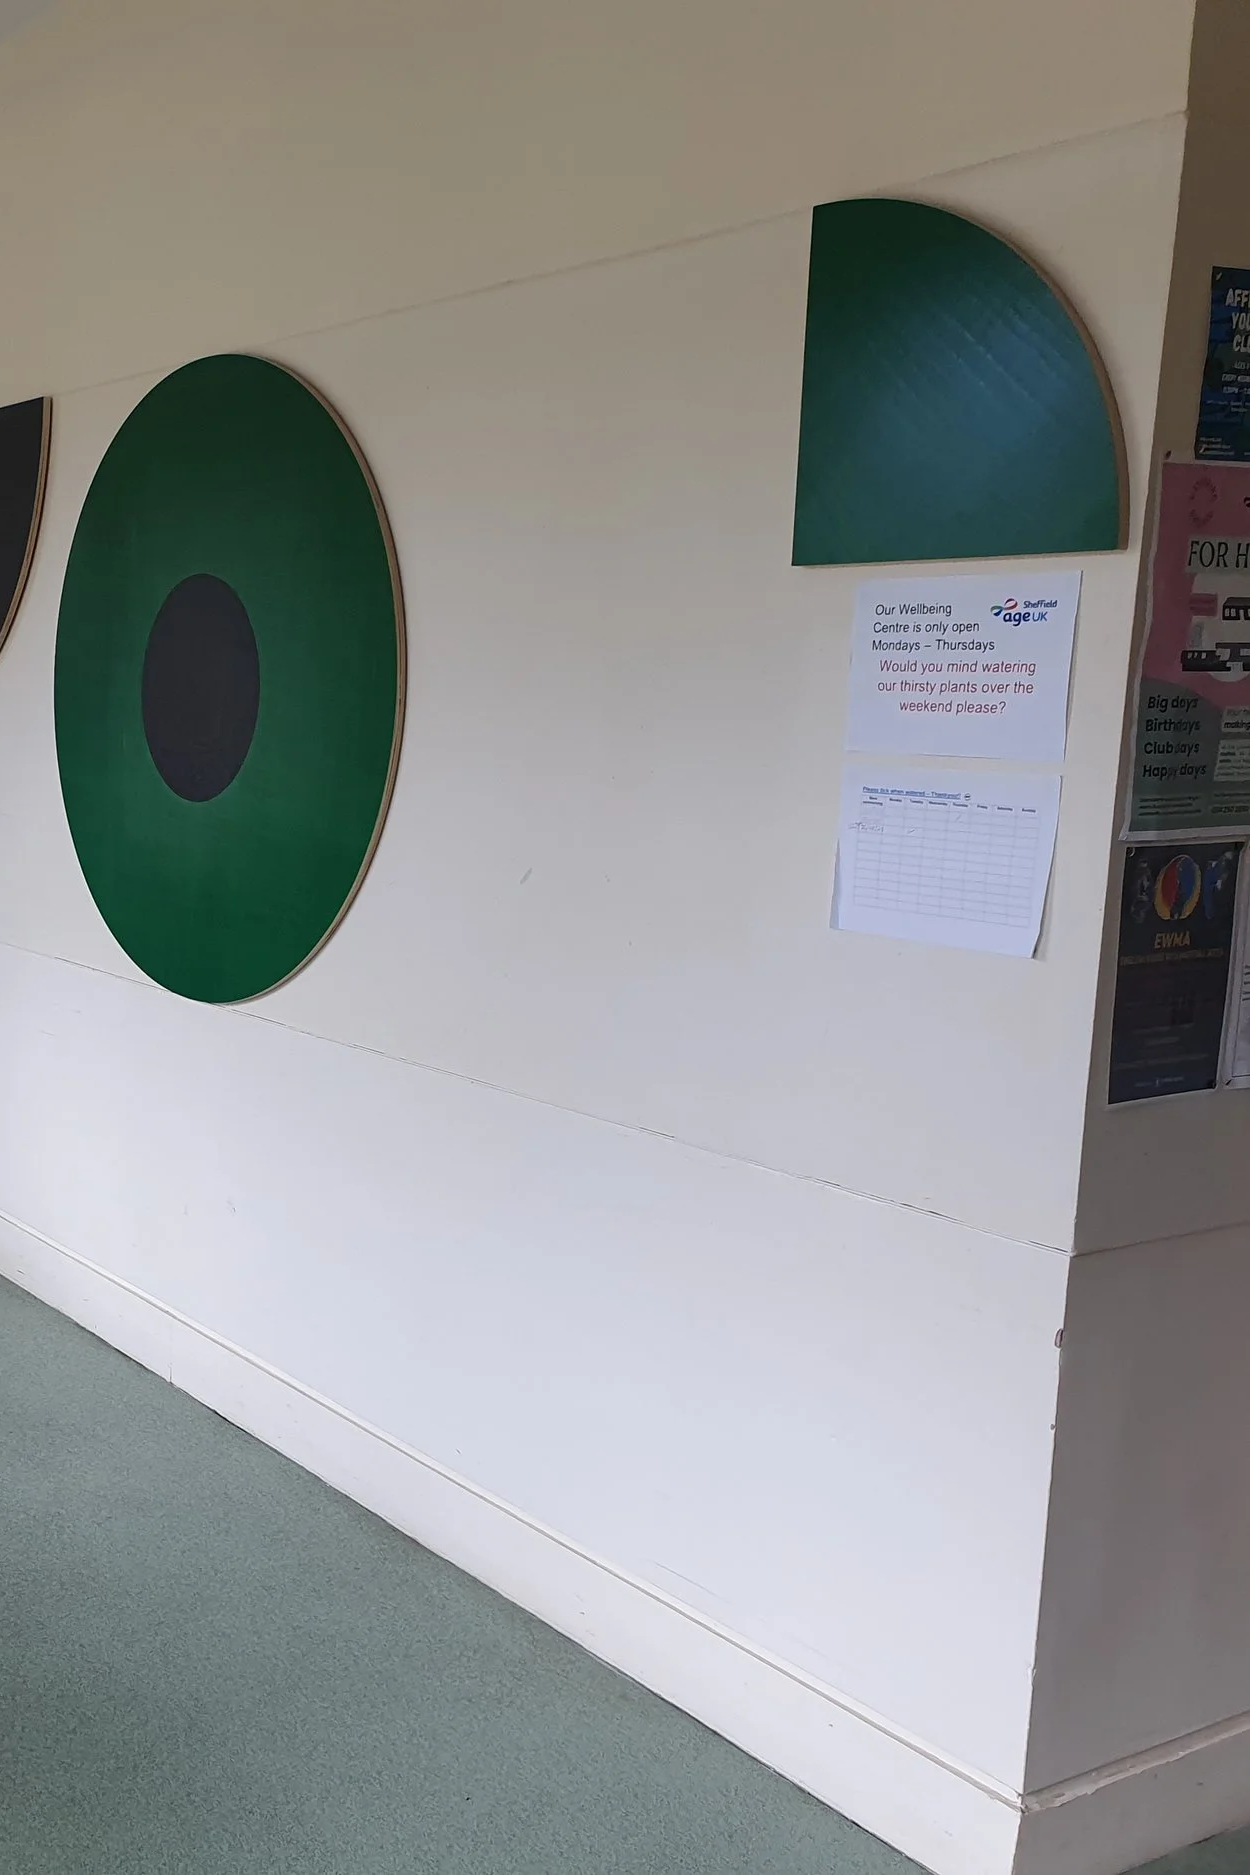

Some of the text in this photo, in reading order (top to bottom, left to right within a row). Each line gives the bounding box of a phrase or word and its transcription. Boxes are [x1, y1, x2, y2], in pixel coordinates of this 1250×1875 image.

[1188, 540, 1228, 568] FOR
[875, 602, 952, 617] Our Wellbeing
[1023, 600, 1058, 609] Sheffield
[873, 621, 980, 636] Centre is only open
[872, 639, 921, 653] Mondays
[935, 639, 995, 653] Thursdays
[879, 659, 1036, 676] Would you mind watering
[877, 679, 1034, 695] our thirsty plants over the
[899, 700, 1007, 716] weekend please?
[1148, 695, 1198, 713] Big days
[1145, 718, 1201, 736] Birthdays
[1180, 763, 1207, 779] days
[1154, 930, 1191, 950] EWMA
